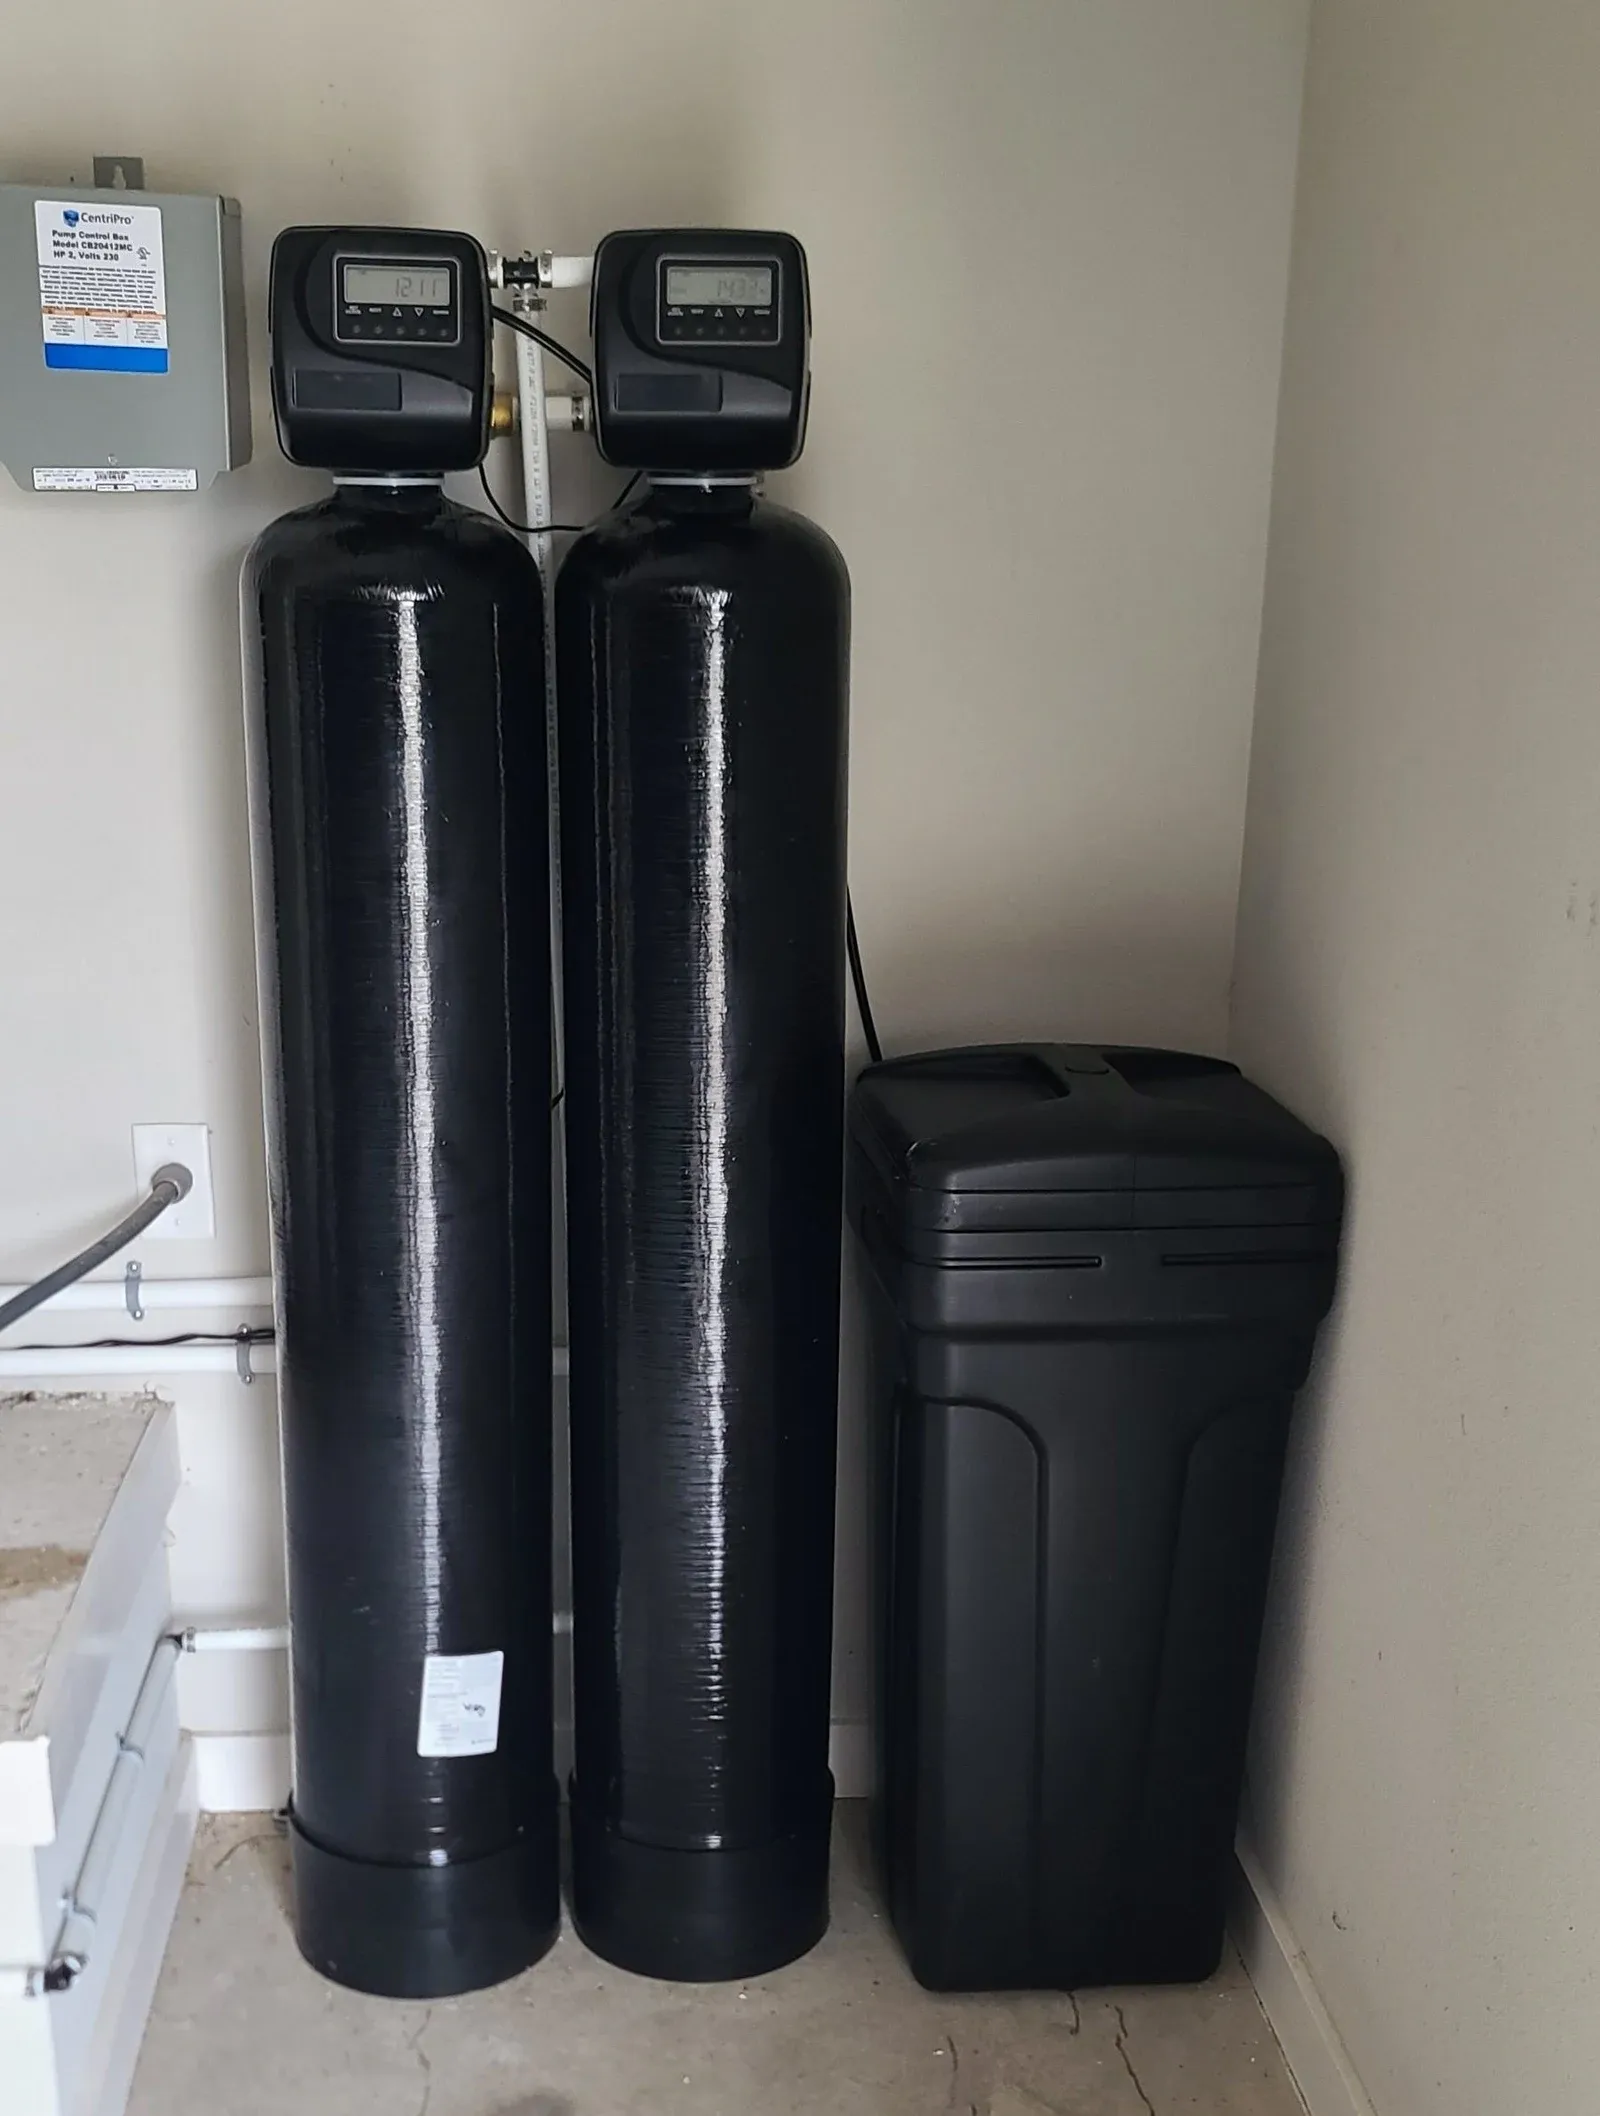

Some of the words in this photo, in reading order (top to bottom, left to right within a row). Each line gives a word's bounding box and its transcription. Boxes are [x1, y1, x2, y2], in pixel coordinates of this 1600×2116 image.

[81, 212, 132, 225] CentriPro
[52, 230, 76, 239] Pump
[79, 231, 110, 240] Control
[113, 233, 129, 241] Box
[53, 240, 79, 248] Model
[78, 252, 101, 260] Volts
[103, 253, 119, 261] 230
